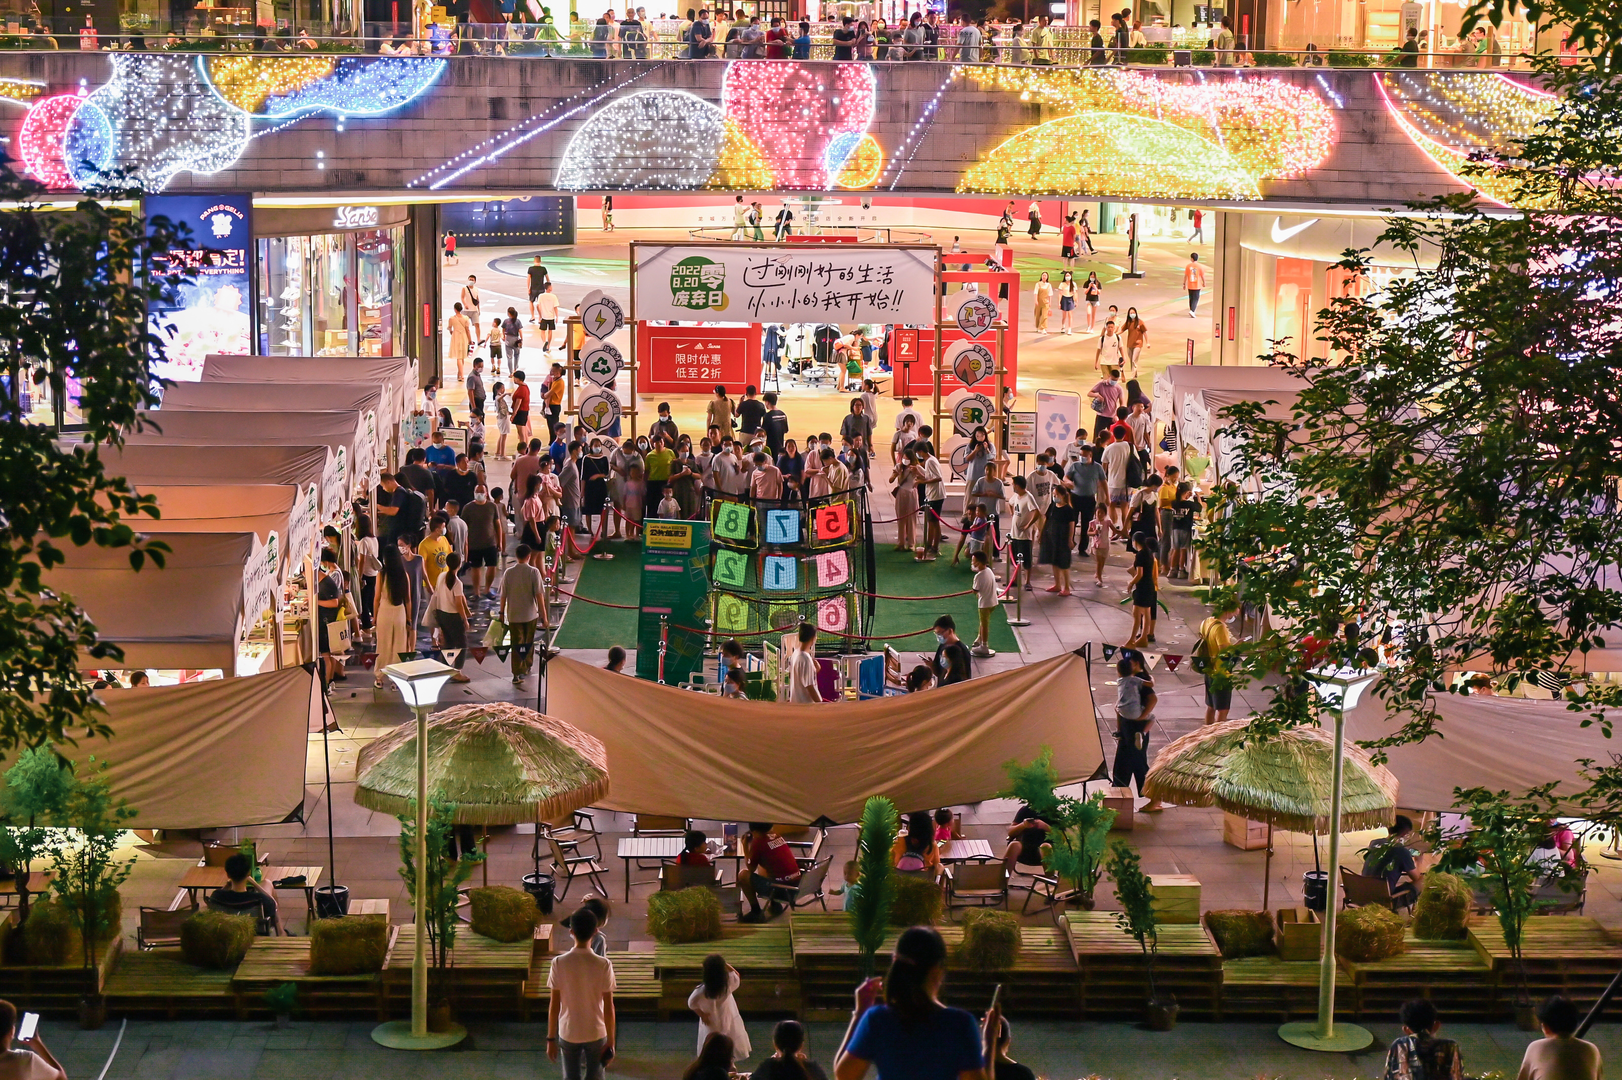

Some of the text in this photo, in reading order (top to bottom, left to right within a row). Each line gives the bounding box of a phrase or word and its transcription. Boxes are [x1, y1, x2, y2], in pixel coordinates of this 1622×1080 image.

[672, 265, 700, 275] 2022
[700, 263, 726, 289] 零
[743, 257, 894, 287] 过刚刚好的生活
[672, 277, 699, 288] 8.20
[672, 290, 723, 306] 废弃日
[675, 354, 722, 365] 限时优惠
[675, 367, 722, 379] 低至2折
[961, 407, 984, 423] 3R
